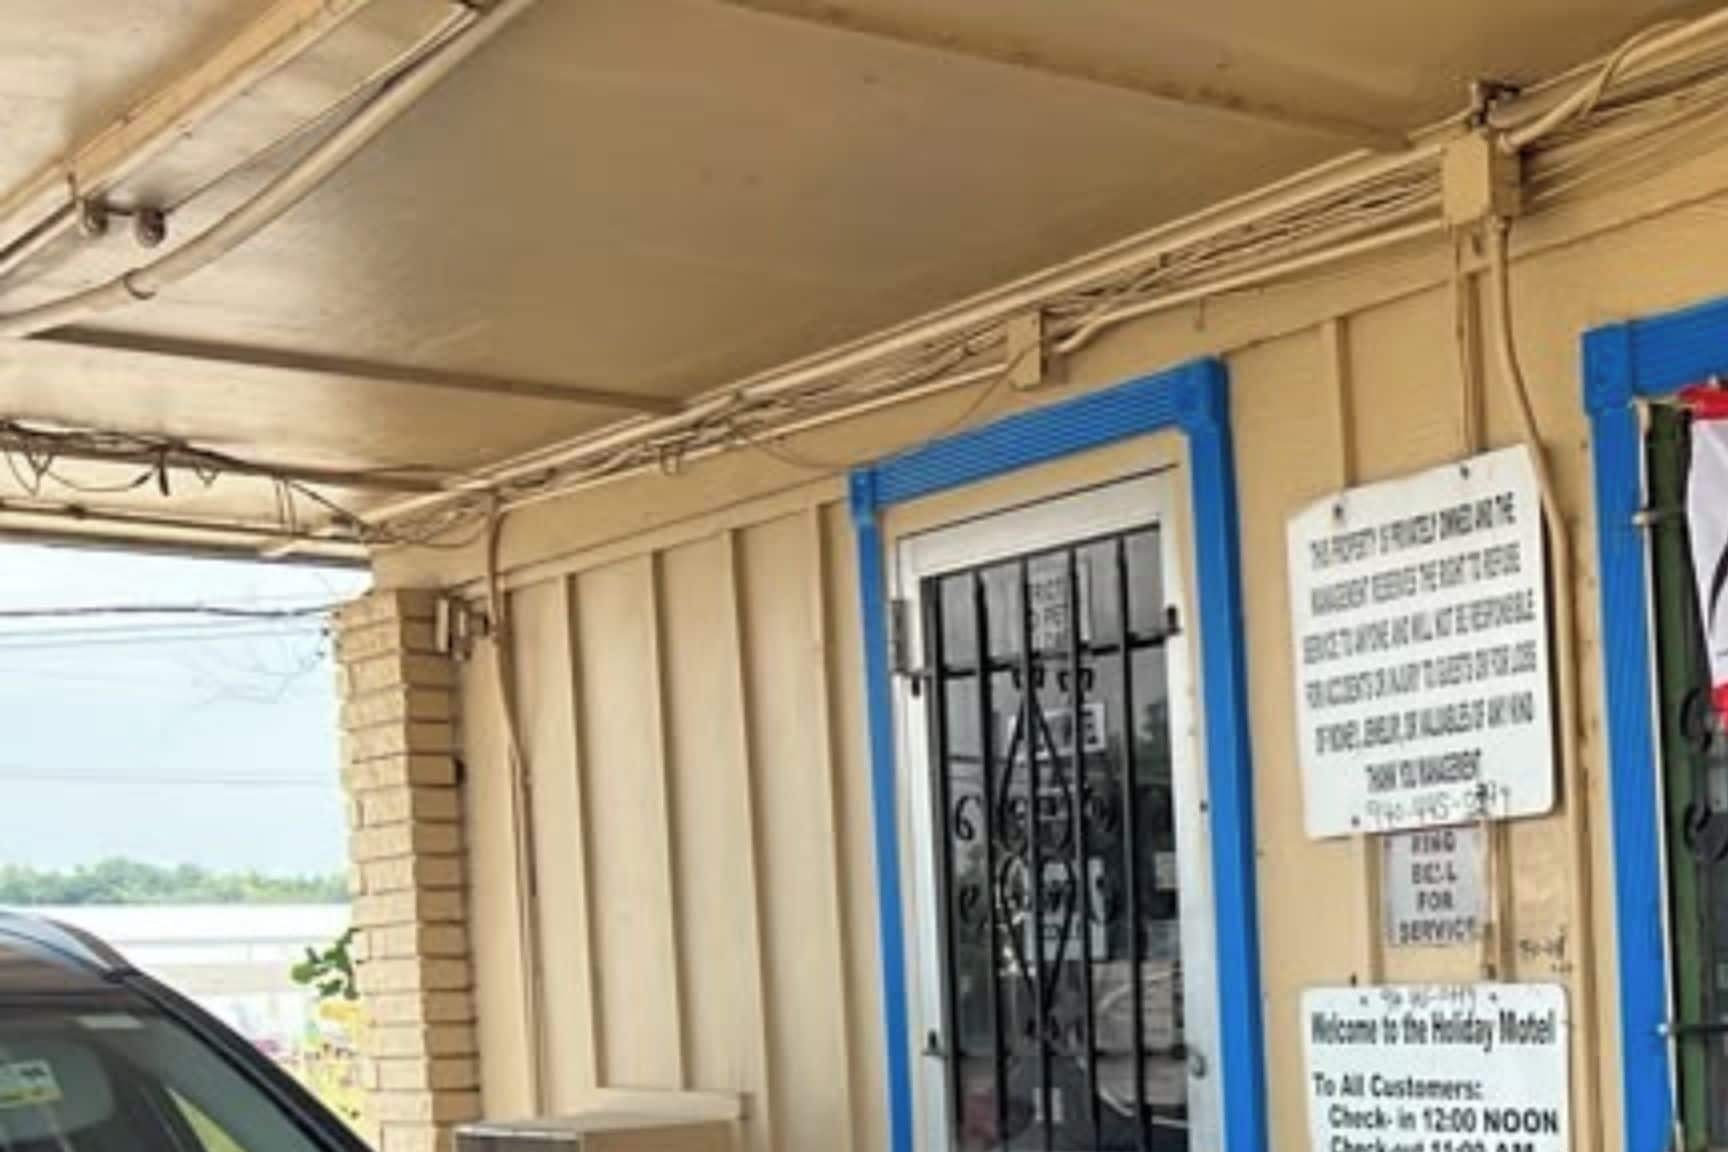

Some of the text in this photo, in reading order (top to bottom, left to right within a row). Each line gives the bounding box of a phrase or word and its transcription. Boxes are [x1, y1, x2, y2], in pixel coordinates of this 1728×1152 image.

[1416, 889, 1454, 912] FOR
[1311, 1007, 1557, 1053] Welcome to the Holiday Motel
[1312, 1071, 1484, 1101] To All Customers:
[1422, 1107, 1477, 1133] 12:00
[1483, 1108, 1560, 1134] NOON
